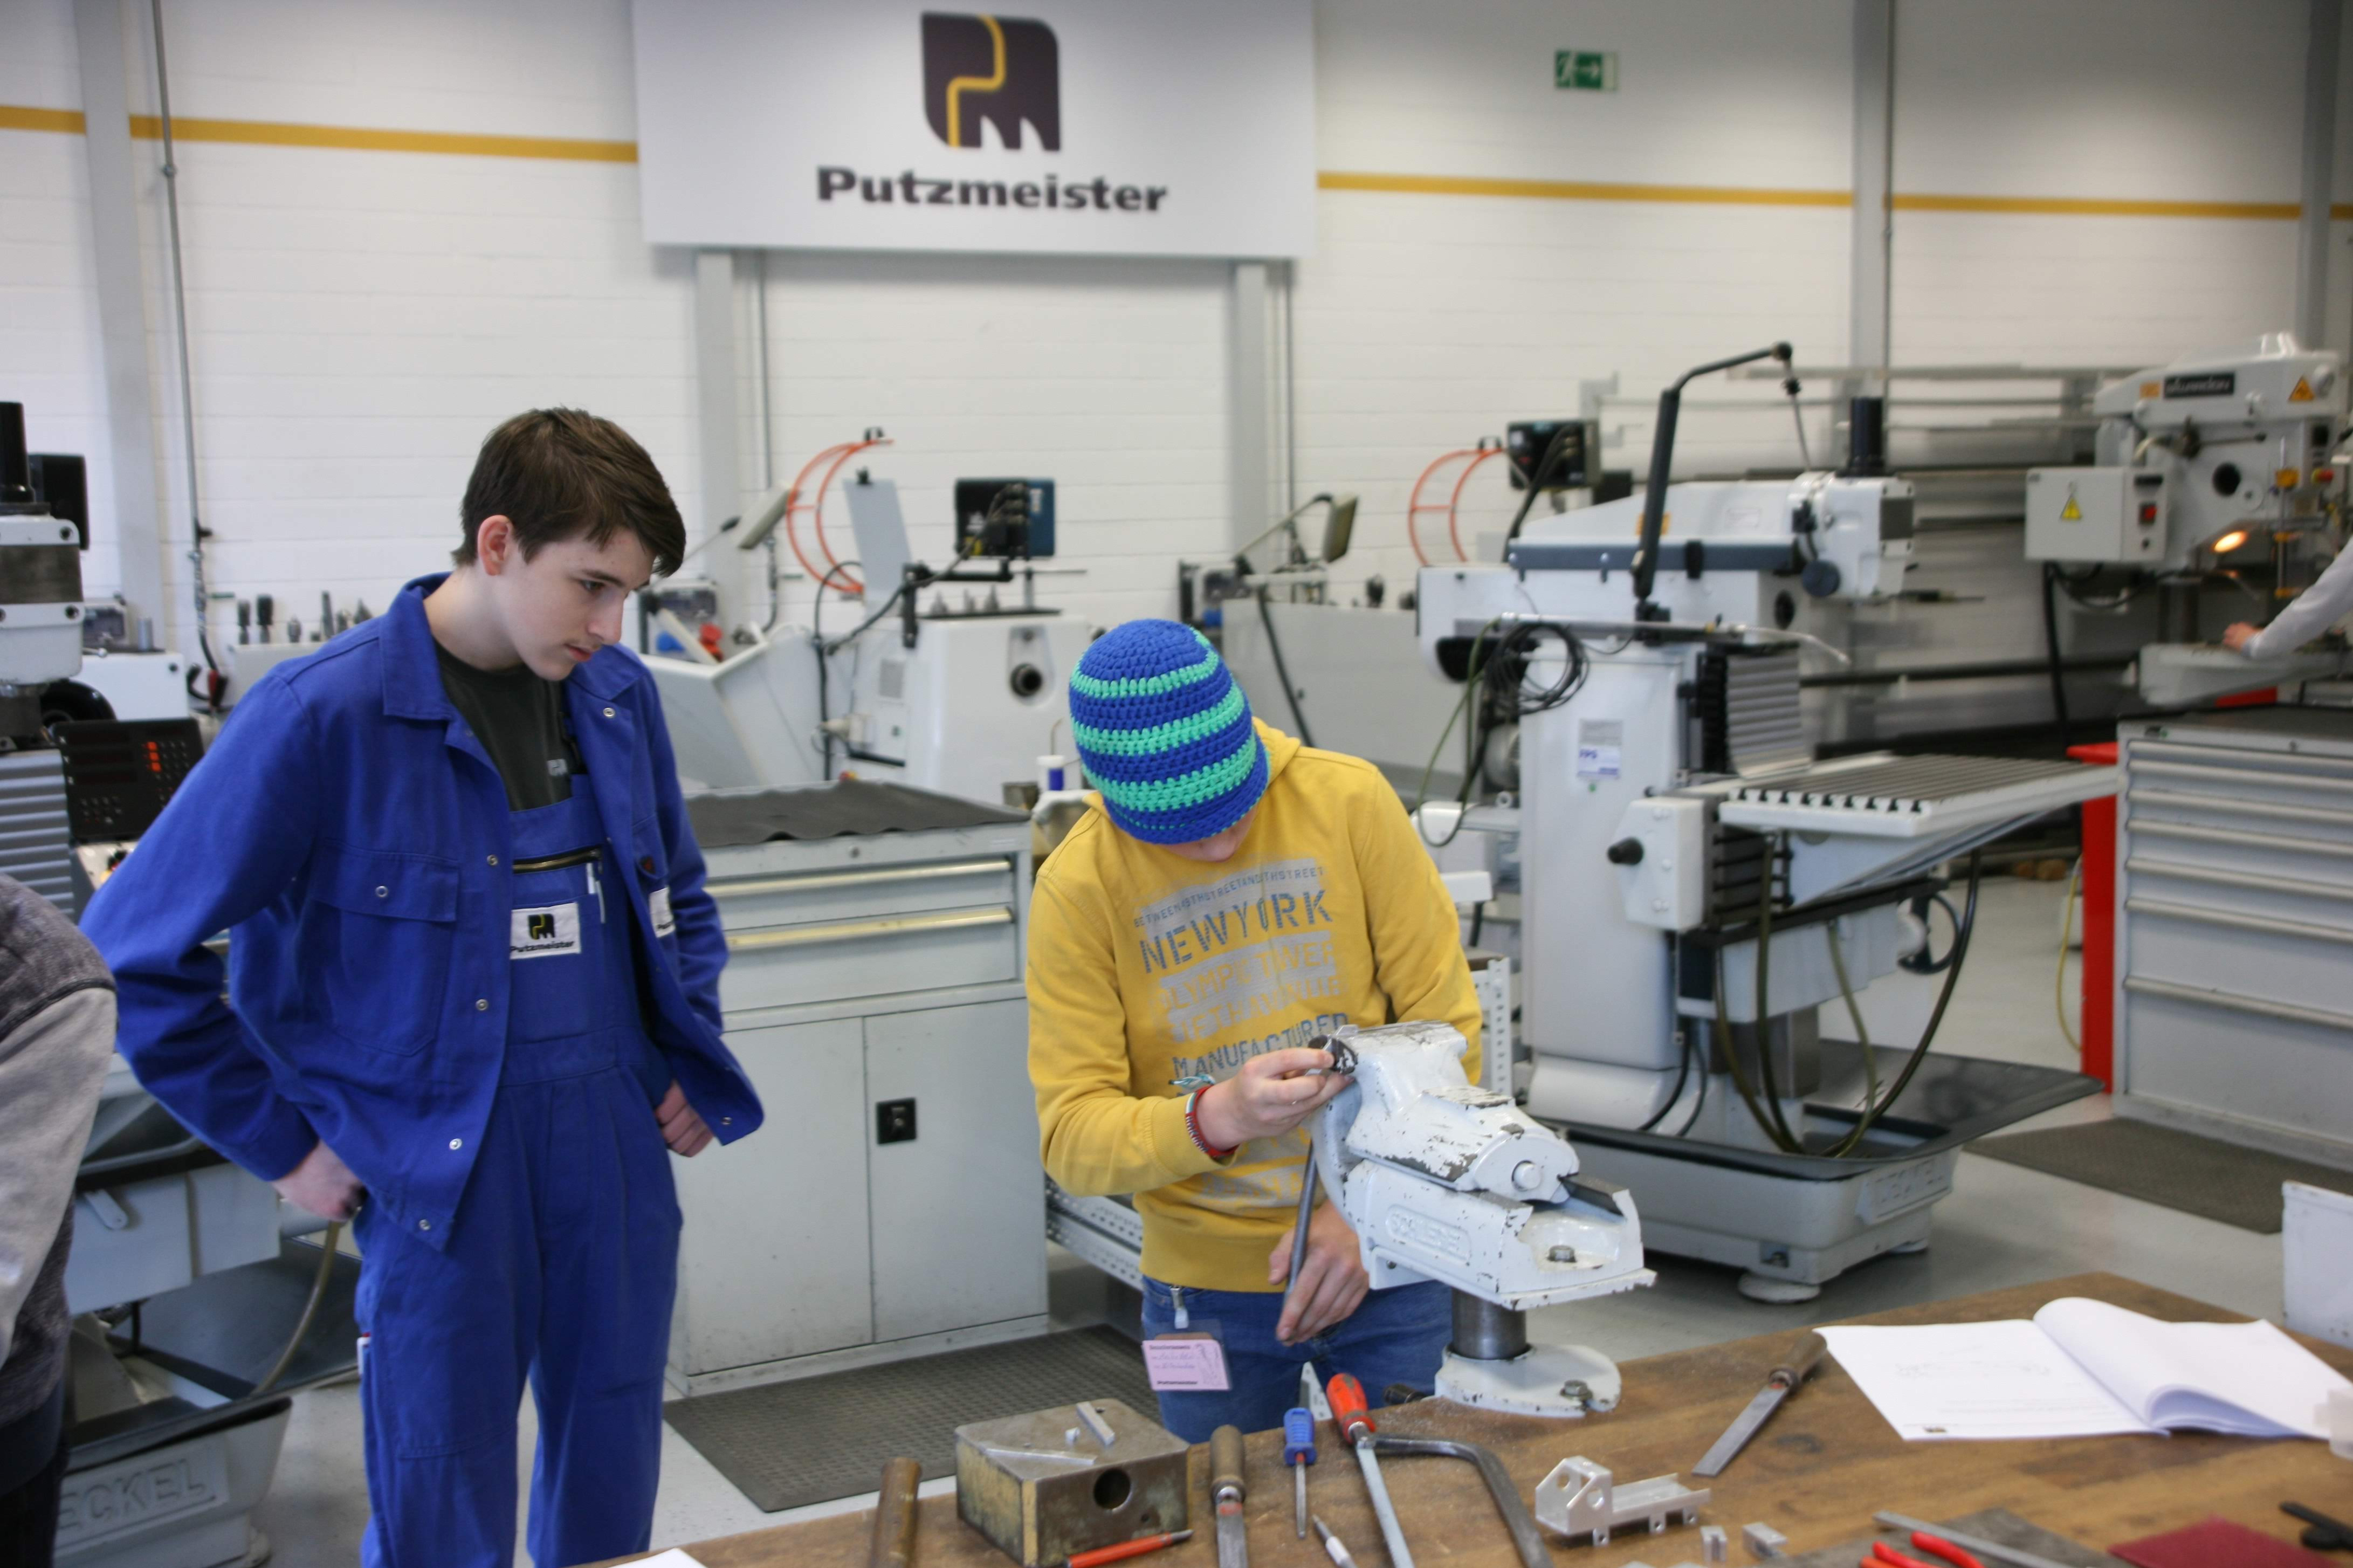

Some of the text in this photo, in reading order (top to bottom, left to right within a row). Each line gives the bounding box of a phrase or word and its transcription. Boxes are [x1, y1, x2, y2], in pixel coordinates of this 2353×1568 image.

[817, 166, 1167, 211] Putzmeister
[509, 940, 575, 953] Putzmeister
[58, 1457, 207, 1532] ECKEL
